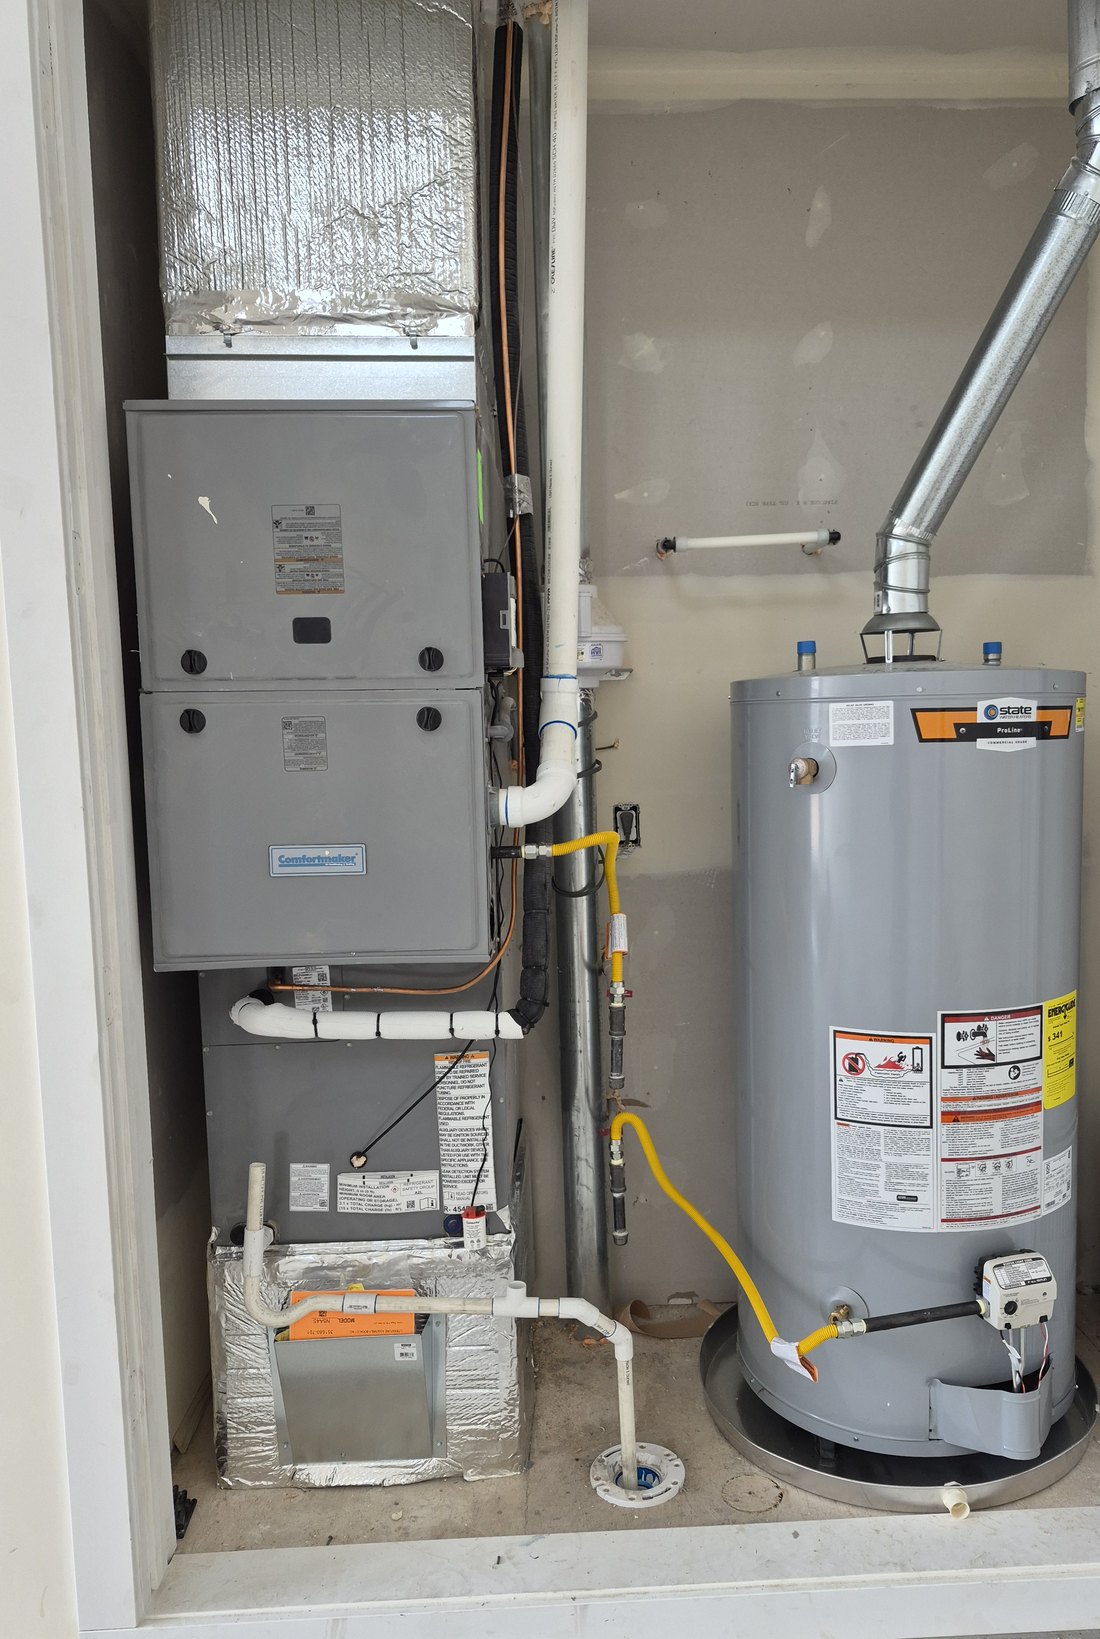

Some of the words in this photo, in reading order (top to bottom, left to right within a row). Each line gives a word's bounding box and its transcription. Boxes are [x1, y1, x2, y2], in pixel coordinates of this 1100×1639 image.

[1000, 706, 1032, 715] state
[278, 854, 356, 864] Comfortmaker
[1052, 1030, 1062, 1040] 341
